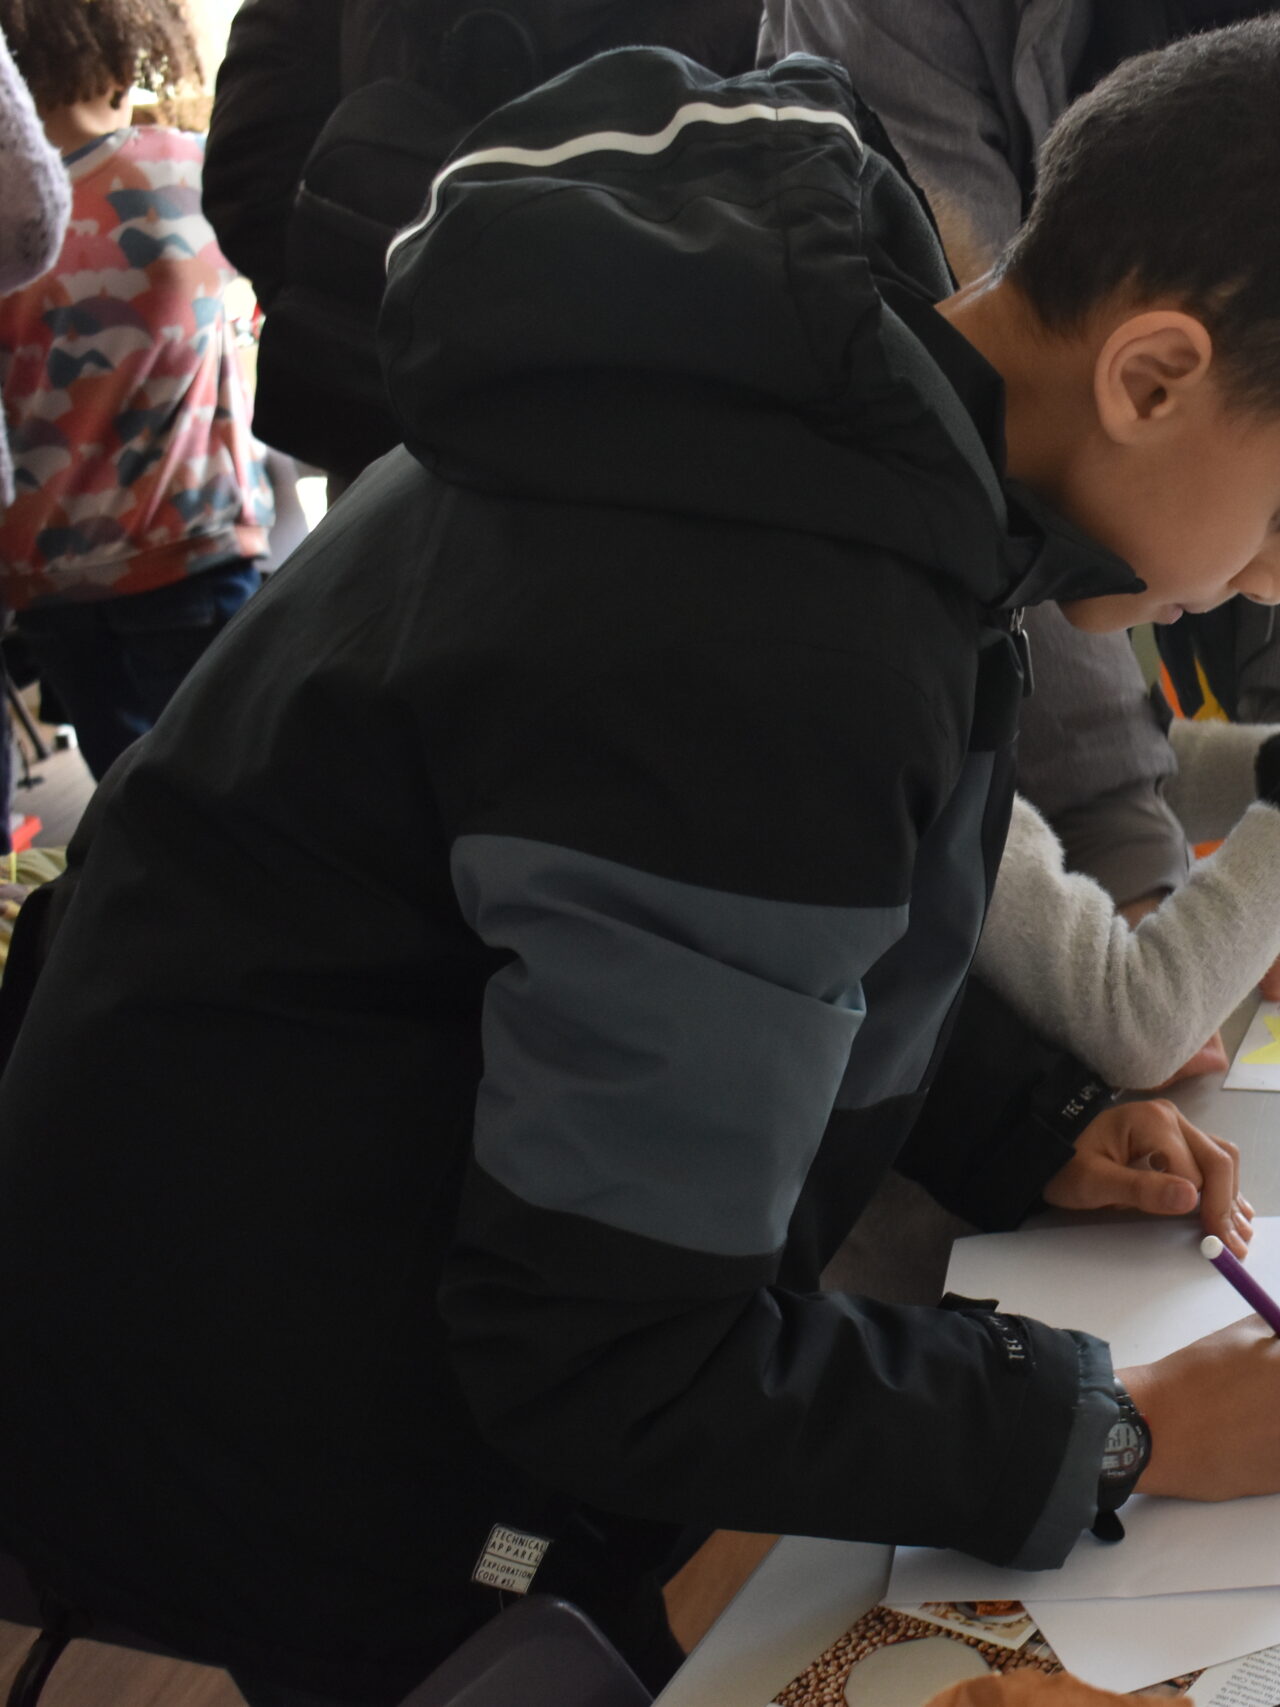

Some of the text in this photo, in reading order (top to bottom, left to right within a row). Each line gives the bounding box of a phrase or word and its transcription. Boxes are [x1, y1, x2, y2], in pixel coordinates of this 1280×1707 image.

[495, 1530, 545, 1551] TECHNICAL
[490, 1541, 541, 1562] APPAREL
[478, 1569, 498, 1584] CODE
[482, 1559, 532, 1579] EXPLORATION
